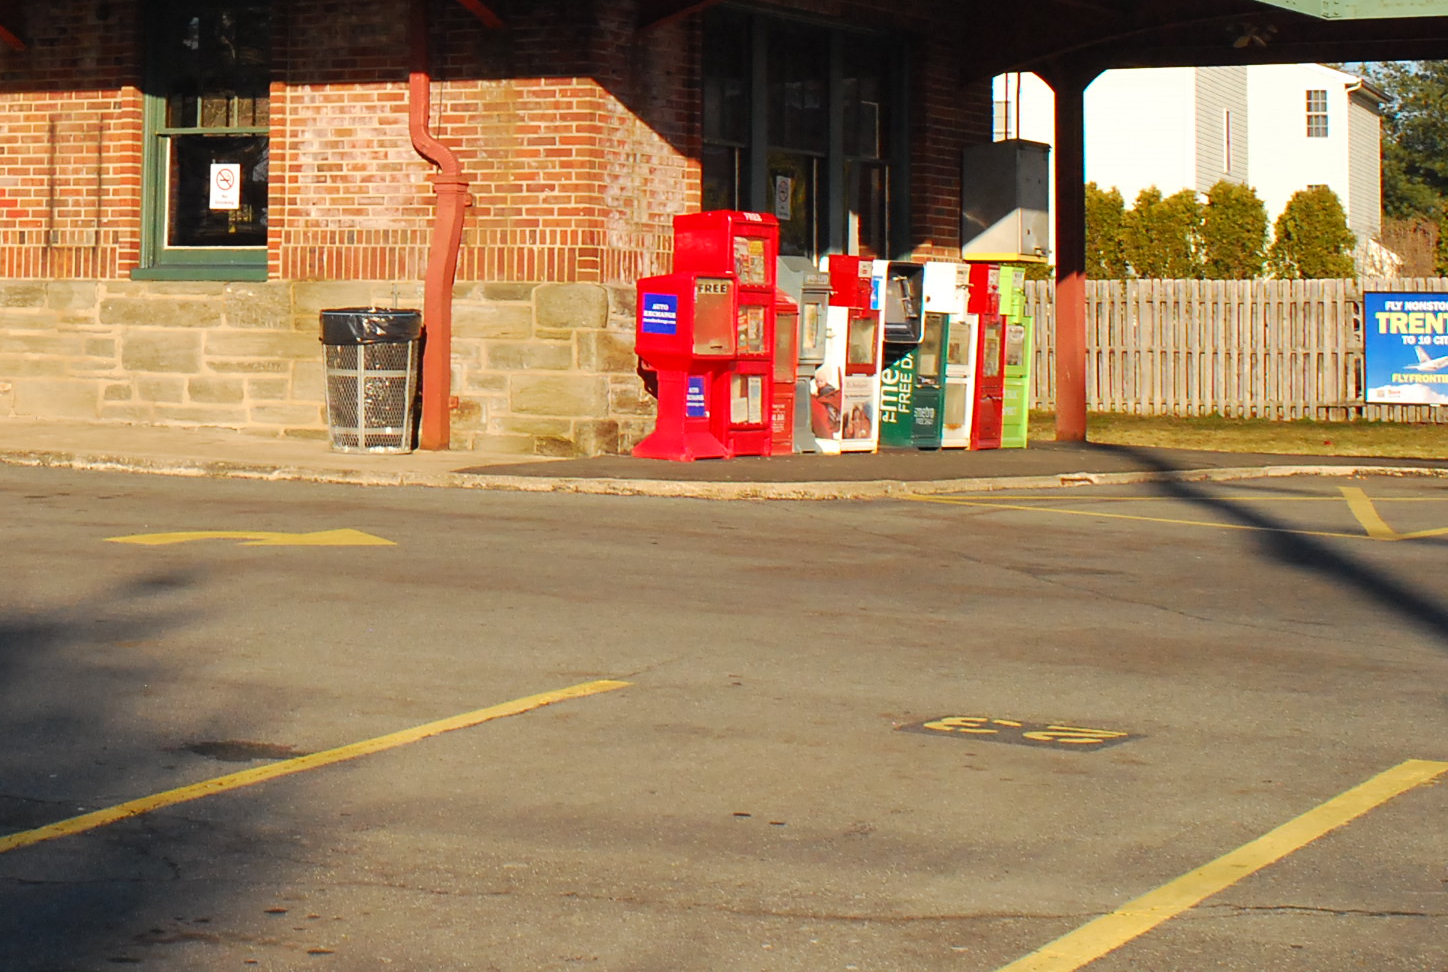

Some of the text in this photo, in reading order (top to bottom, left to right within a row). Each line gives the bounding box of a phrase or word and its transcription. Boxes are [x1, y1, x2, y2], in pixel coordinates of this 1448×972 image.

[698, 284, 727, 293] FREE
[1385, 301, 1403, 311] FLY
[1402, 335, 1416, 345] TO
[1418, 335, 1431, 345] 10
[899, 373, 912, 413] FREE
